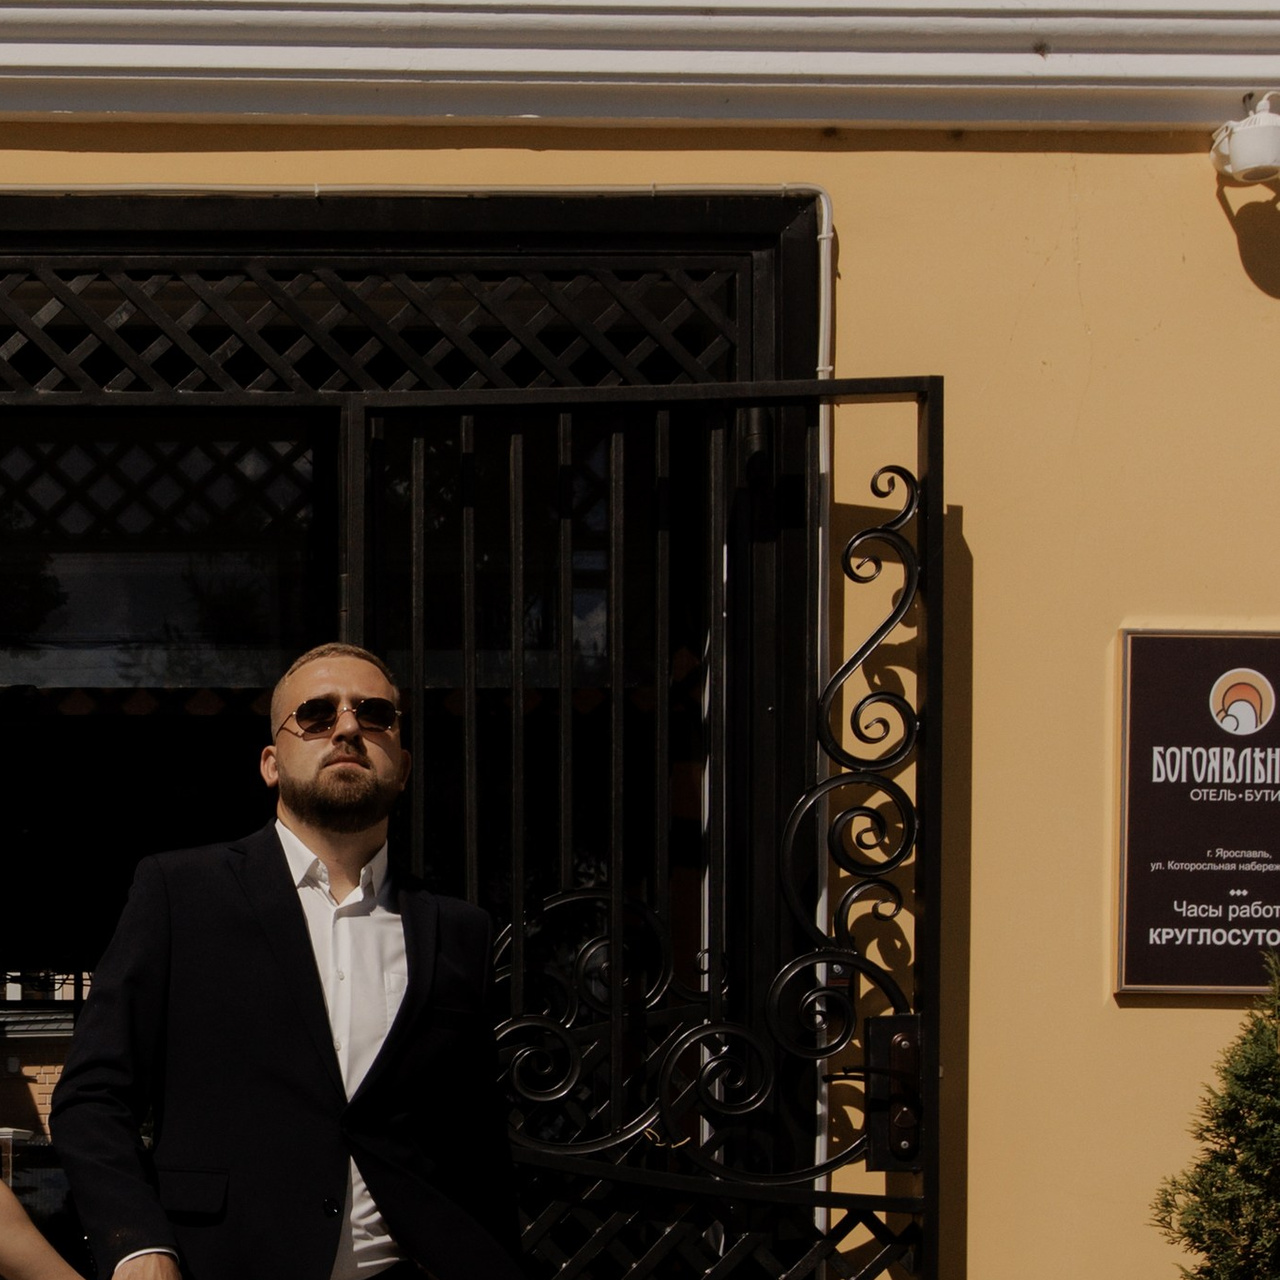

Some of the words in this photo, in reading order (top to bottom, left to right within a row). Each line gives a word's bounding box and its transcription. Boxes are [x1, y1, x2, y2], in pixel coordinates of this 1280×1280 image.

[1215, 848, 1272, 860] Ярославль,
[1150, 861, 1165, 872] ул.
[1173, 900, 1222, 918] Часы
[1228, 901, 1280, 922] работ
[1149, 928, 1280, 946] КРУГЛОСУТО
